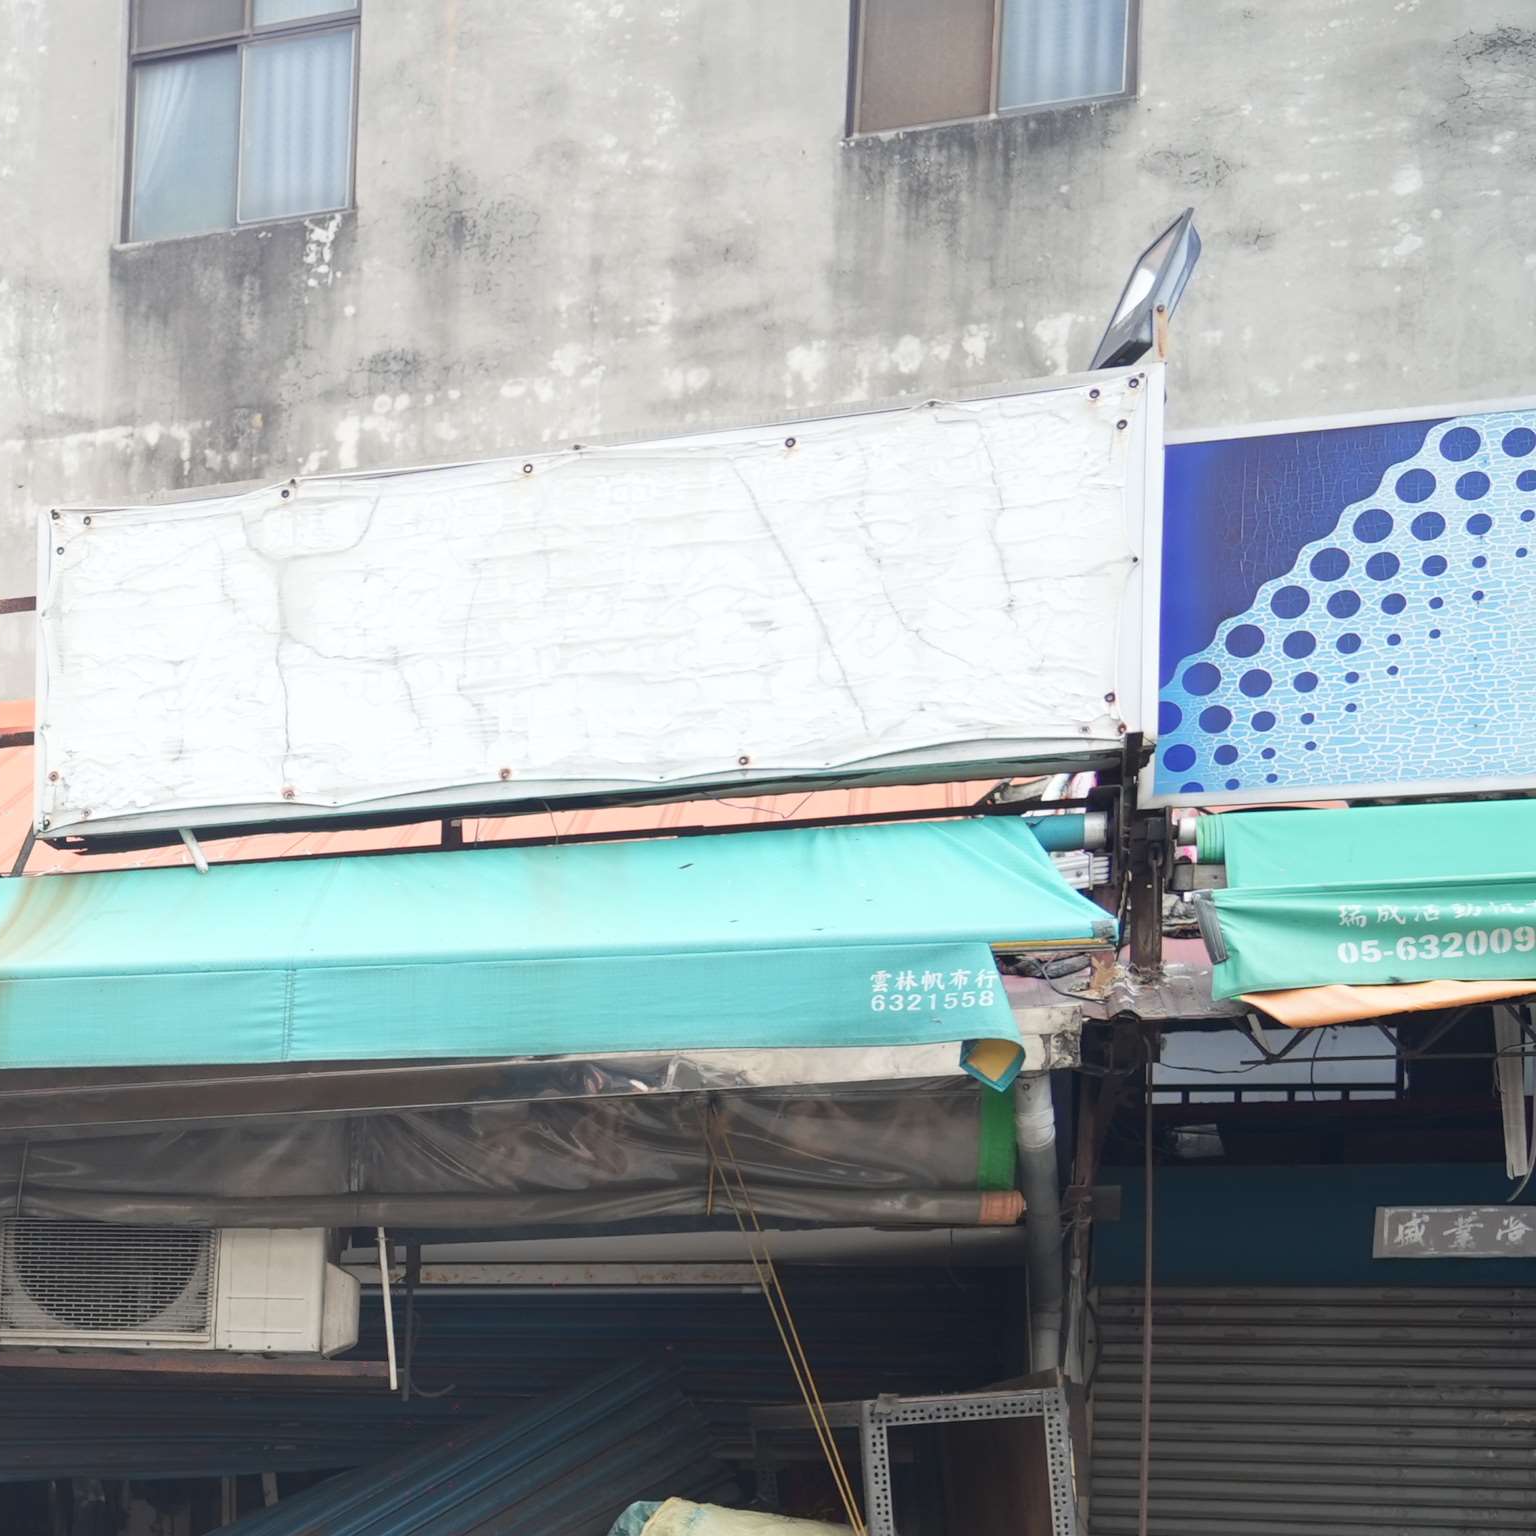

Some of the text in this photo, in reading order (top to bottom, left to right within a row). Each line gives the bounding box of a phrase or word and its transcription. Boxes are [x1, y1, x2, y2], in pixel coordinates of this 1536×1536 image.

[1337, 899, 1536, 929] 瑞成活動帆
[1336, 926, 1536, 964] 05-632009
[870, 968, 999, 993] 雲林帆布行
[871, 990, 995, 1012] 6321558
